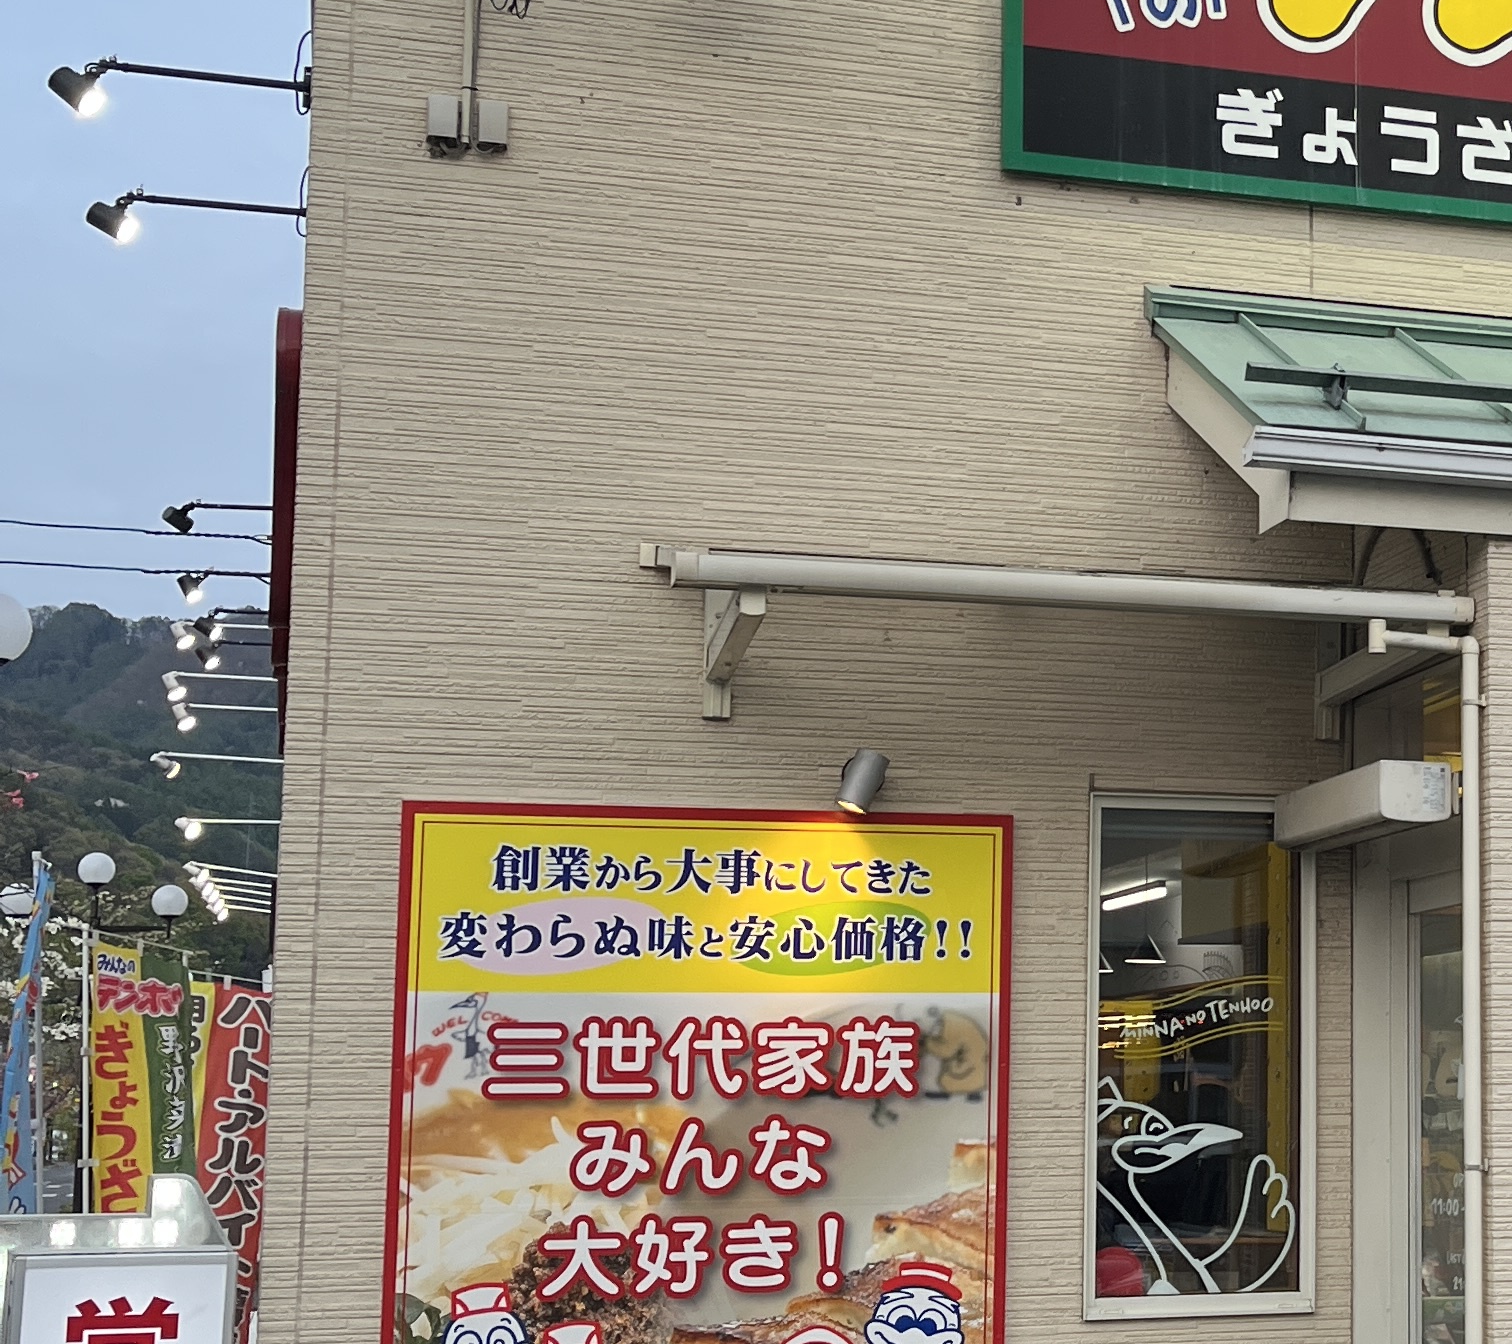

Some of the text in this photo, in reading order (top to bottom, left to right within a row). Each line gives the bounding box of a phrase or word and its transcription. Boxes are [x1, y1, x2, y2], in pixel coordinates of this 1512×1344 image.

[490, 845, 932, 897] 創業から大事にしてきた
[96, 975, 185, 1017] テンホ
[1205, 996, 1274, 1023] TENHOO
[481, 1013, 921, 1103] 三世代家族
[94, 1020, 144, 1213] ぎょうざ
[568, 1114, 832, 1199] みんな
